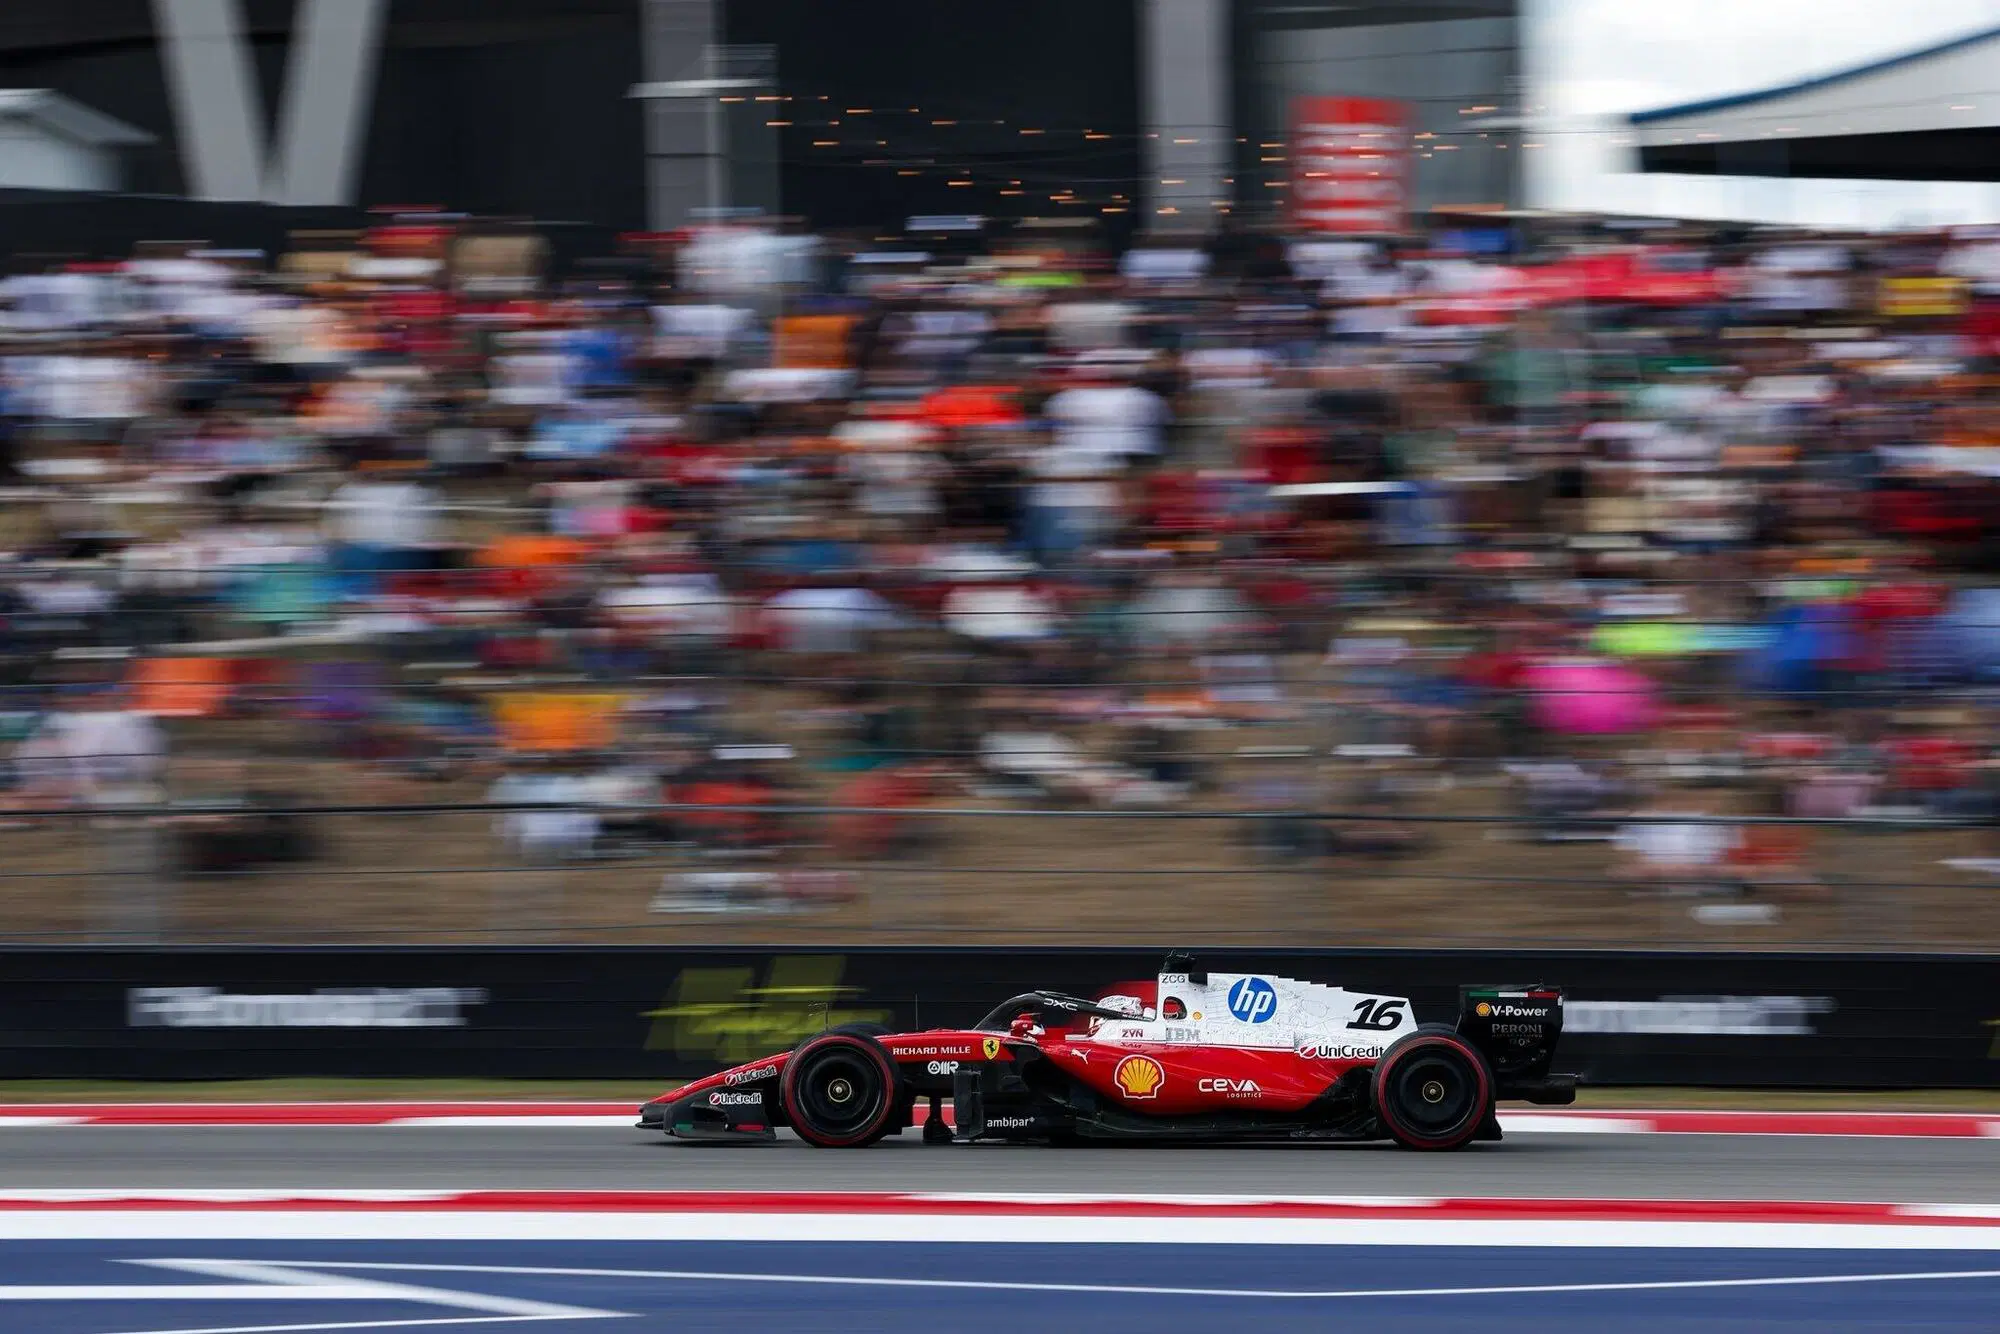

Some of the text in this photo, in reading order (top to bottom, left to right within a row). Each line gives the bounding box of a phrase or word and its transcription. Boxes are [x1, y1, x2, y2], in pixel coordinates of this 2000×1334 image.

[1043, 997, 1079, 1012] DXC
[1231, 977, 1275, 1024] hp
[1346, 998, 1406, 1031] 16
[1491, 1005, 1548, 1017] V-Power
[1166, 1027, 1201, 1042] IBM
[1491, 1023, 1543, 1034] PERONI
[892, 1045, 971, 1056] RICHARD MILLE
[1318, 1045, 1384, 1059] UniCredit
[736, 1065, 777, 1084] UniCredit
[720, 1093, 763, 1105] UniCredit
